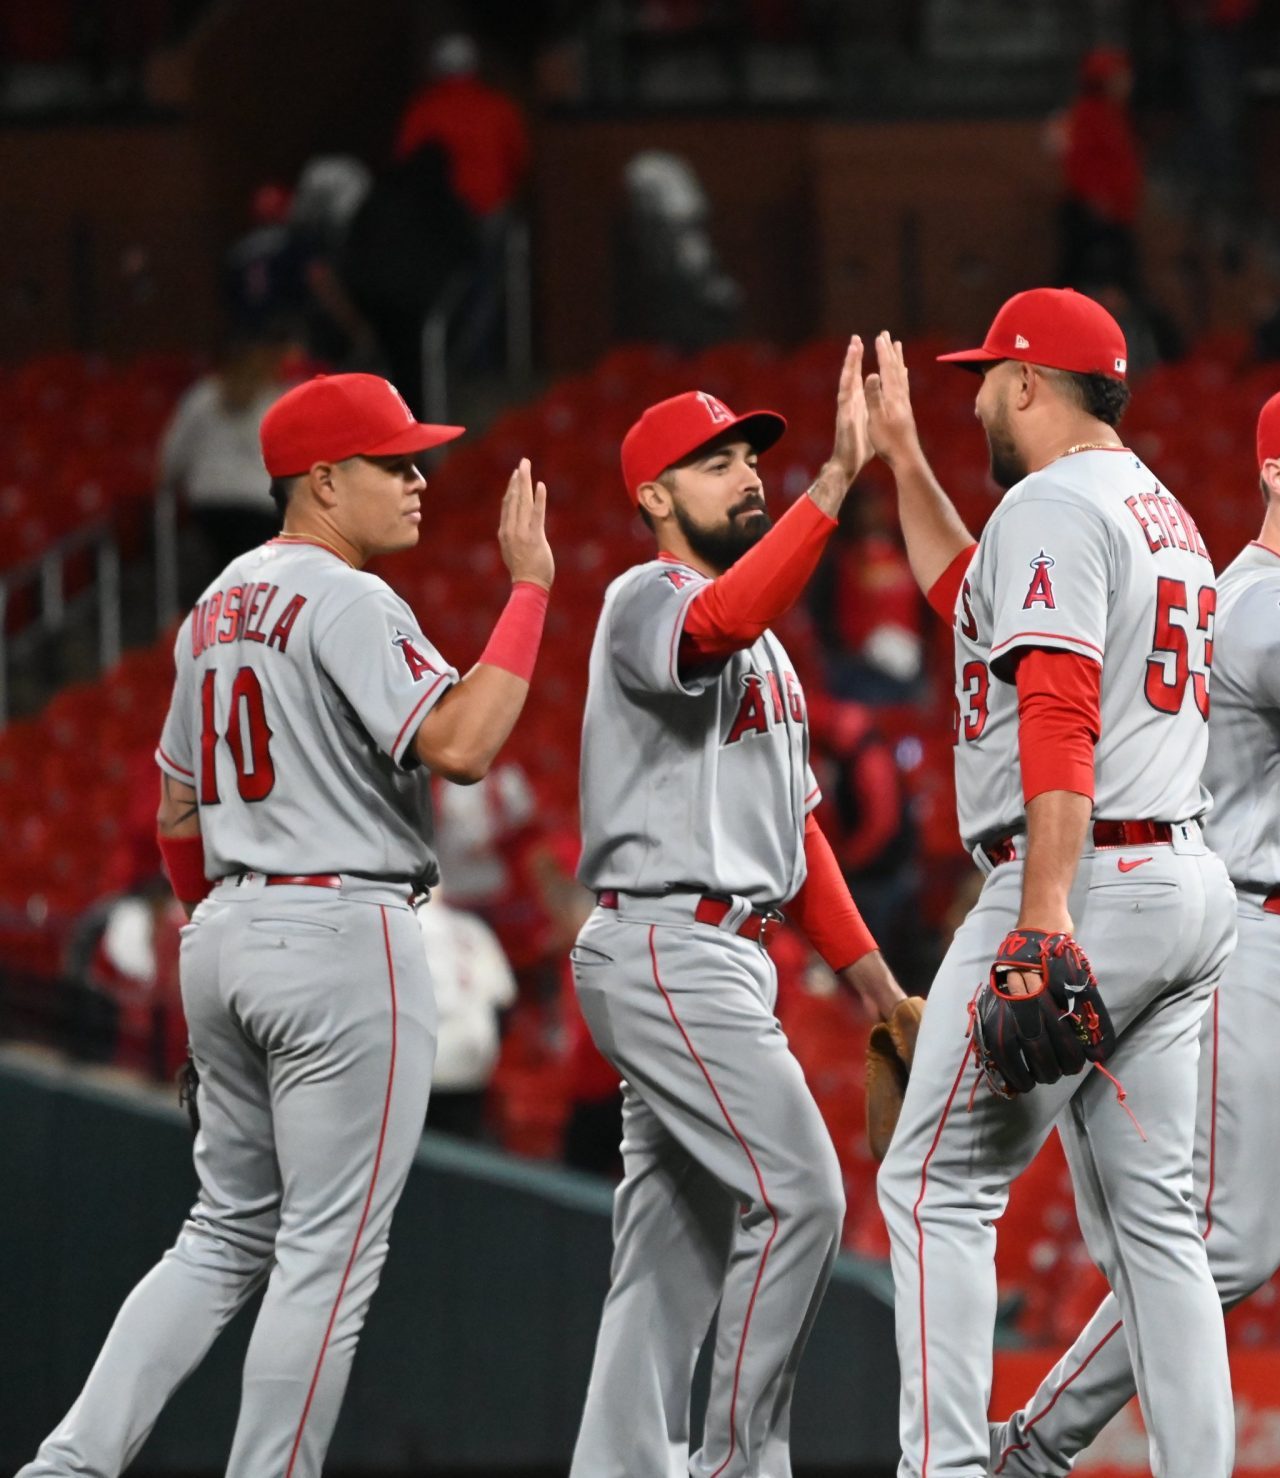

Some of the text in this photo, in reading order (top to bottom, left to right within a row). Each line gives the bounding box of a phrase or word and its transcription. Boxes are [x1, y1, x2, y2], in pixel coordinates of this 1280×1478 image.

[1124, 482, 1212, 563] ESTÉVE
[1022, 549, 1056, 610] A
[192, 582, 307, 660] URSHELA
[392, 628, 441, 683] A
[1144, 576, 1217, 722] 53
[201, 666, 275, 805] 10
